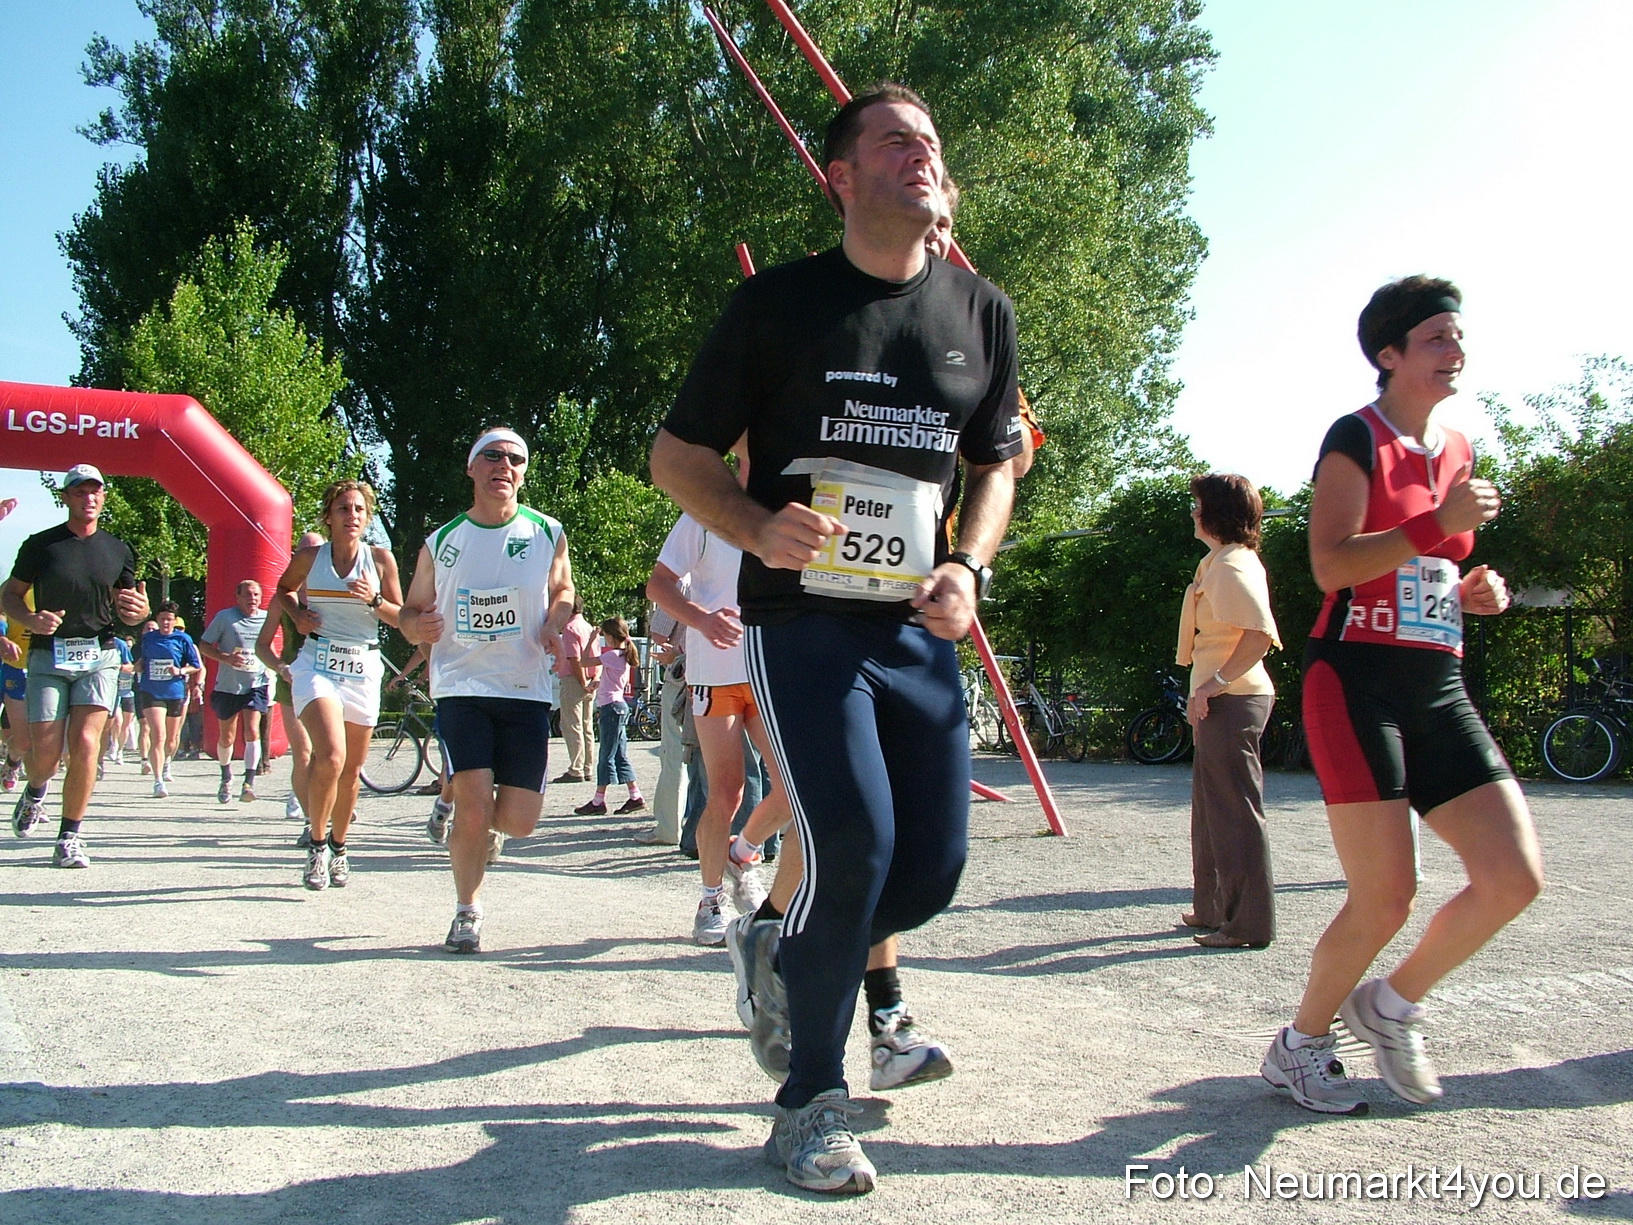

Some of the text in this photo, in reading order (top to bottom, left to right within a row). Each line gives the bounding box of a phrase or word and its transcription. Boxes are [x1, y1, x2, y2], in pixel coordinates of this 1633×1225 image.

[825, 371, 898, 388] powered by
[844, 400, 950, 426] Neumarkter
[7, 409, 140, 440] LGS-Park
[820, 416, 959, 453] Lammsbräu
[844, 495, 894, 519] Peter
[841, 530, 906, 567] 529
[470, 594, 508, 607] Stephen
[1403, 587, 1414, 601] B
[459, 608, 467, 618] C
[472, 609, 516, 629] 2940
[67, 650, 99, 662] 2865
[318, 653, 325, 661] C
[328, 658, 364, 674] 2113
